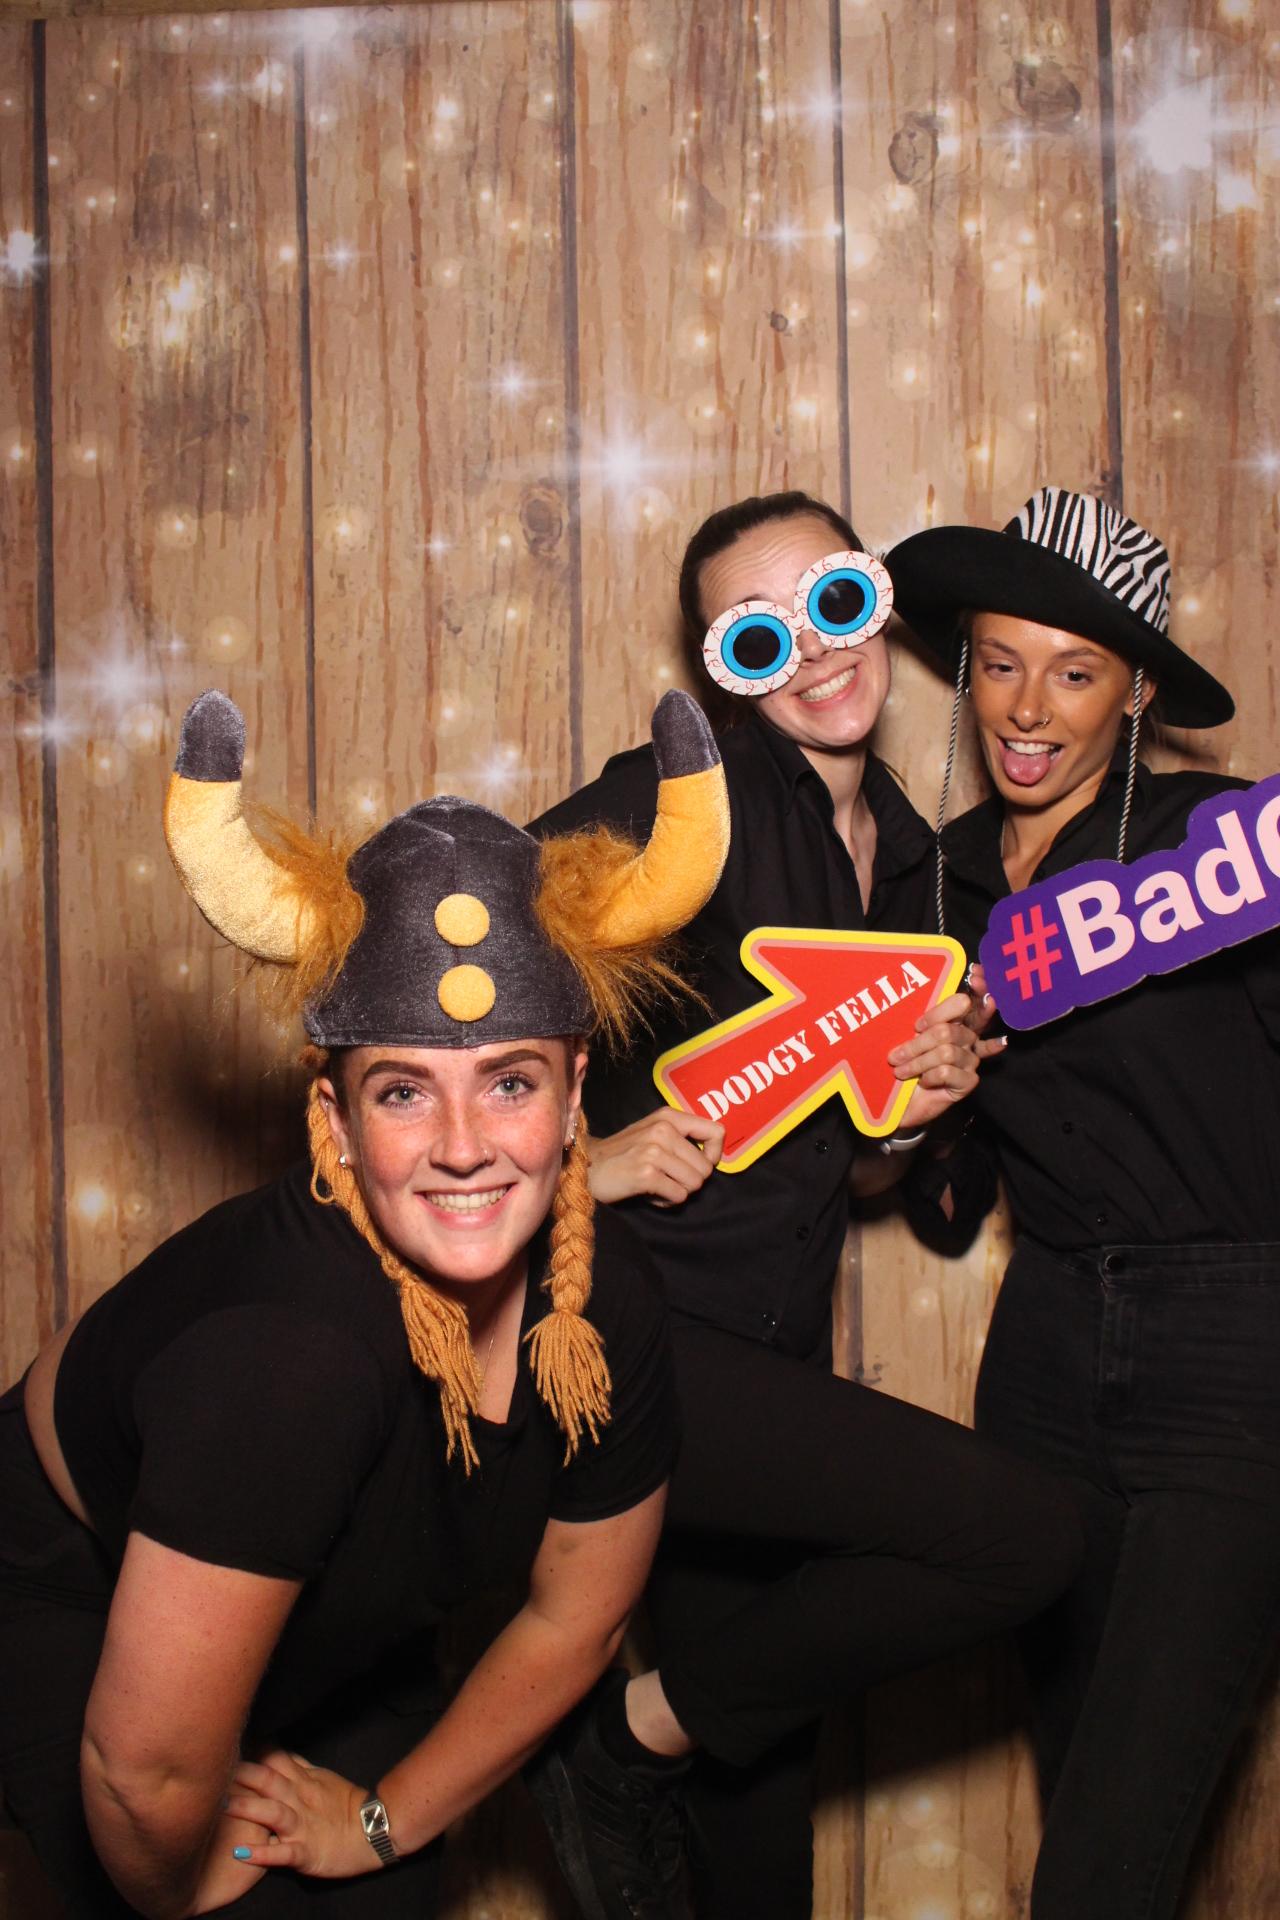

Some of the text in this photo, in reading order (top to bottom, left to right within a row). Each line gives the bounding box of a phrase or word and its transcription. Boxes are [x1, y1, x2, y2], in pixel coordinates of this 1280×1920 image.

[1001, 794, 1280, 1000] #Bad
[697, 960, 930, 1122] DODGY FELLA
